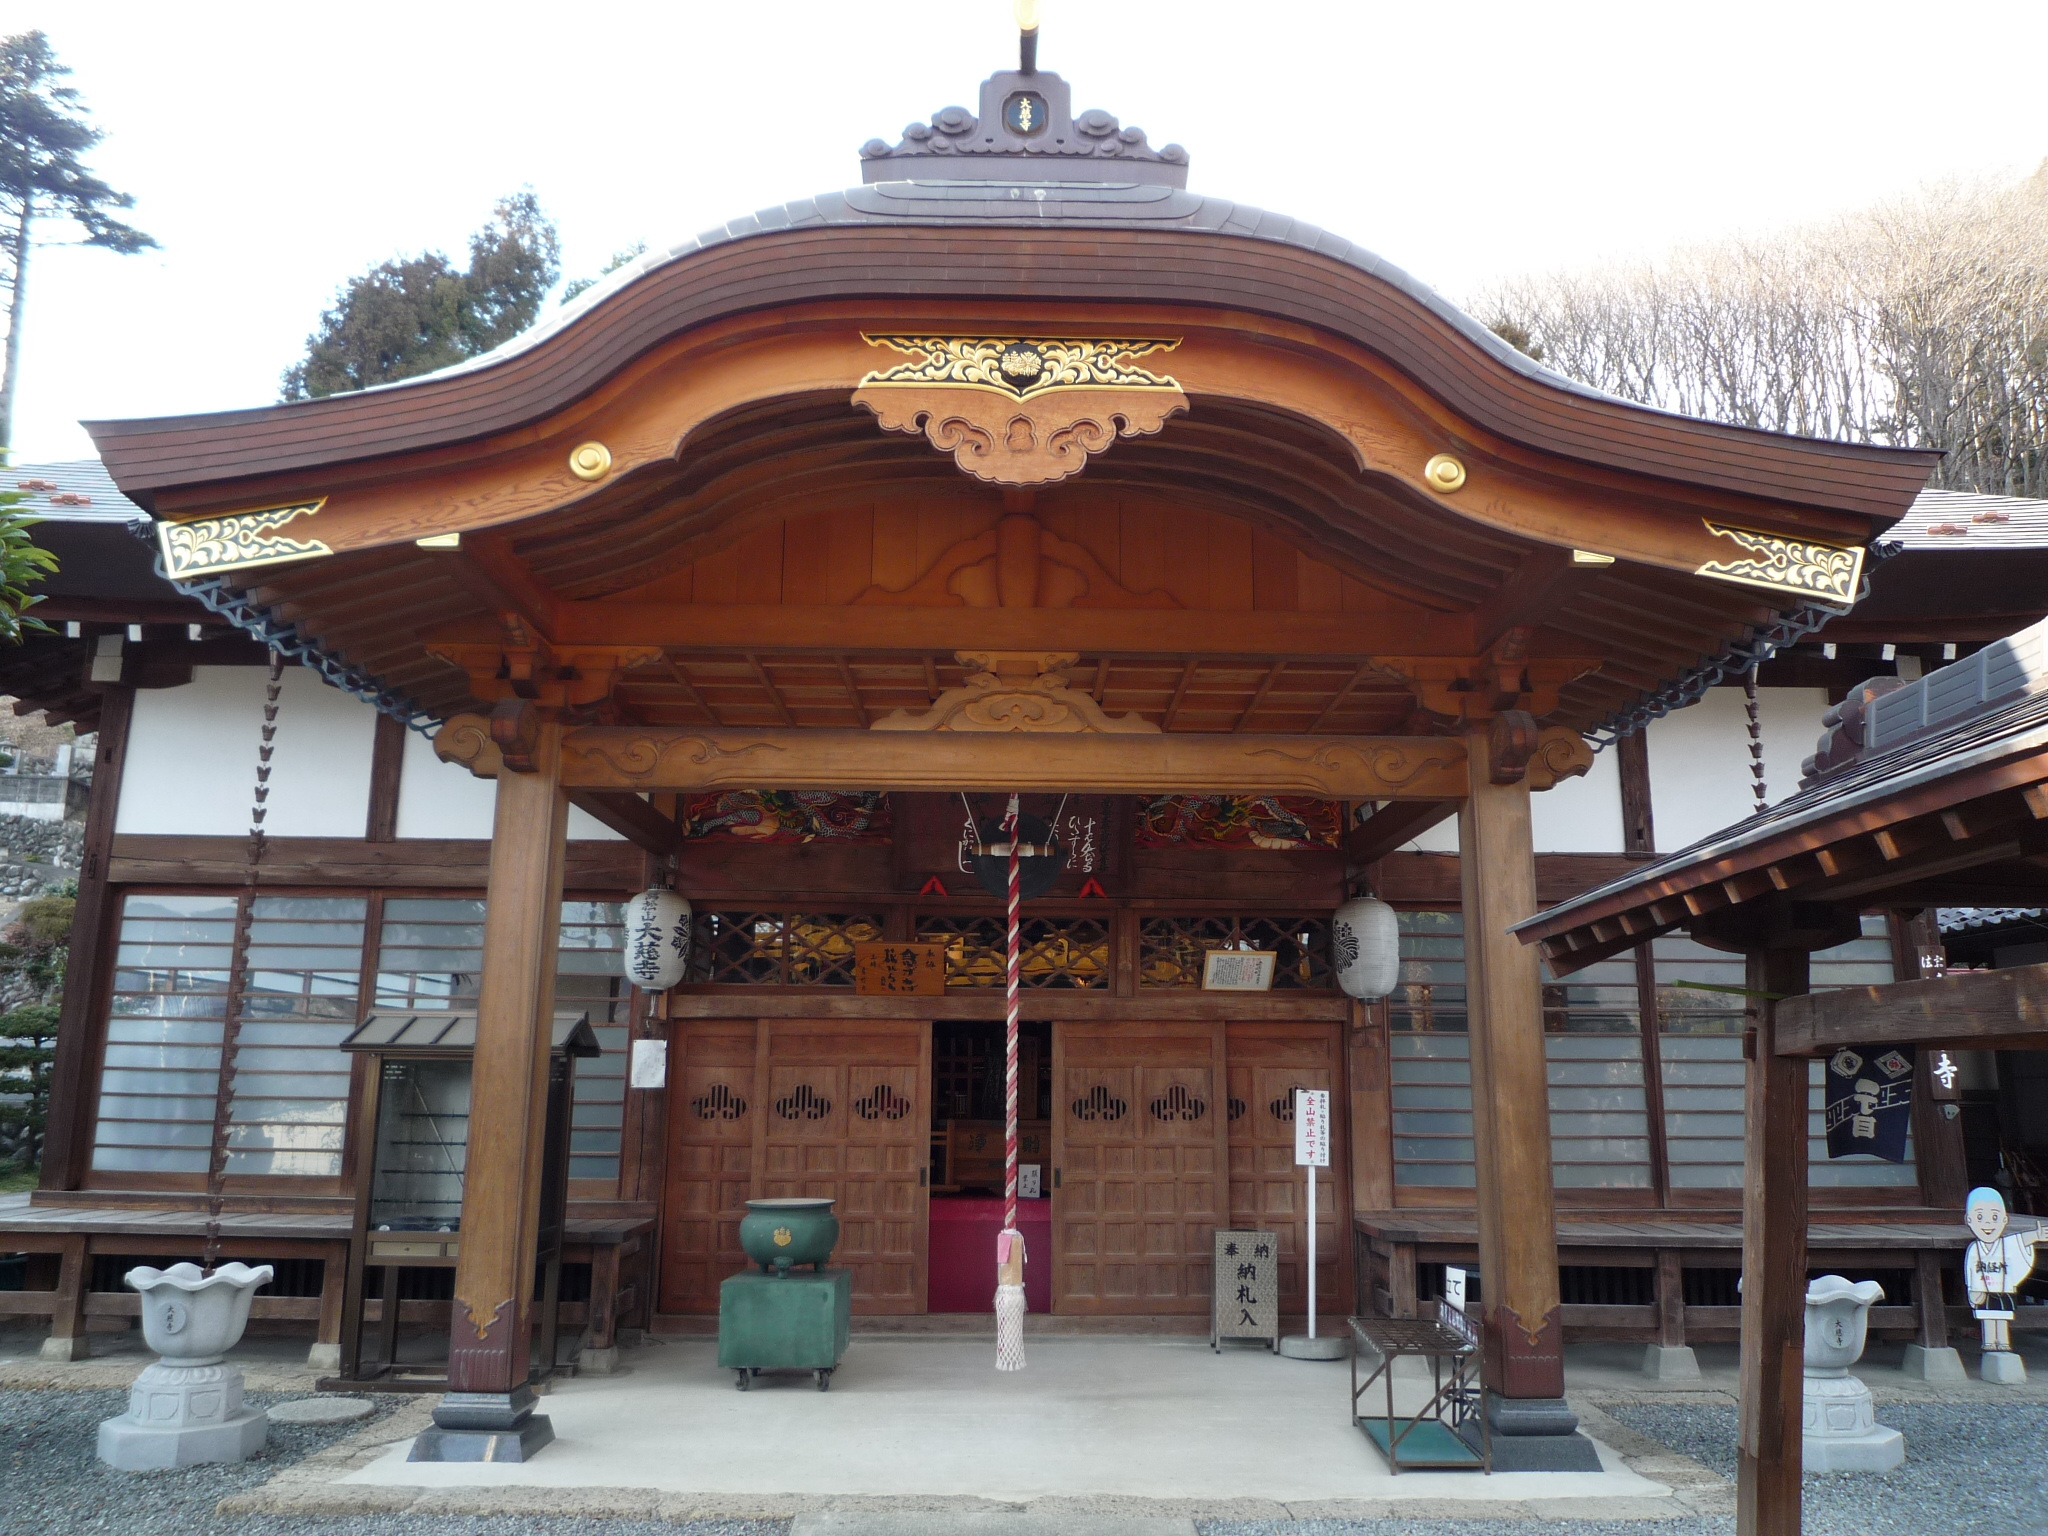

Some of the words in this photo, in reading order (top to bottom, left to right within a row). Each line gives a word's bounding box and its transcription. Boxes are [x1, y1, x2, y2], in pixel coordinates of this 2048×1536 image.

[1019, 97, 1032, 131] 大慈寺
[1305, 1096, 1316, 1159] 全山禁止です
[1236, 1262, 1259, 1326] 納札入
